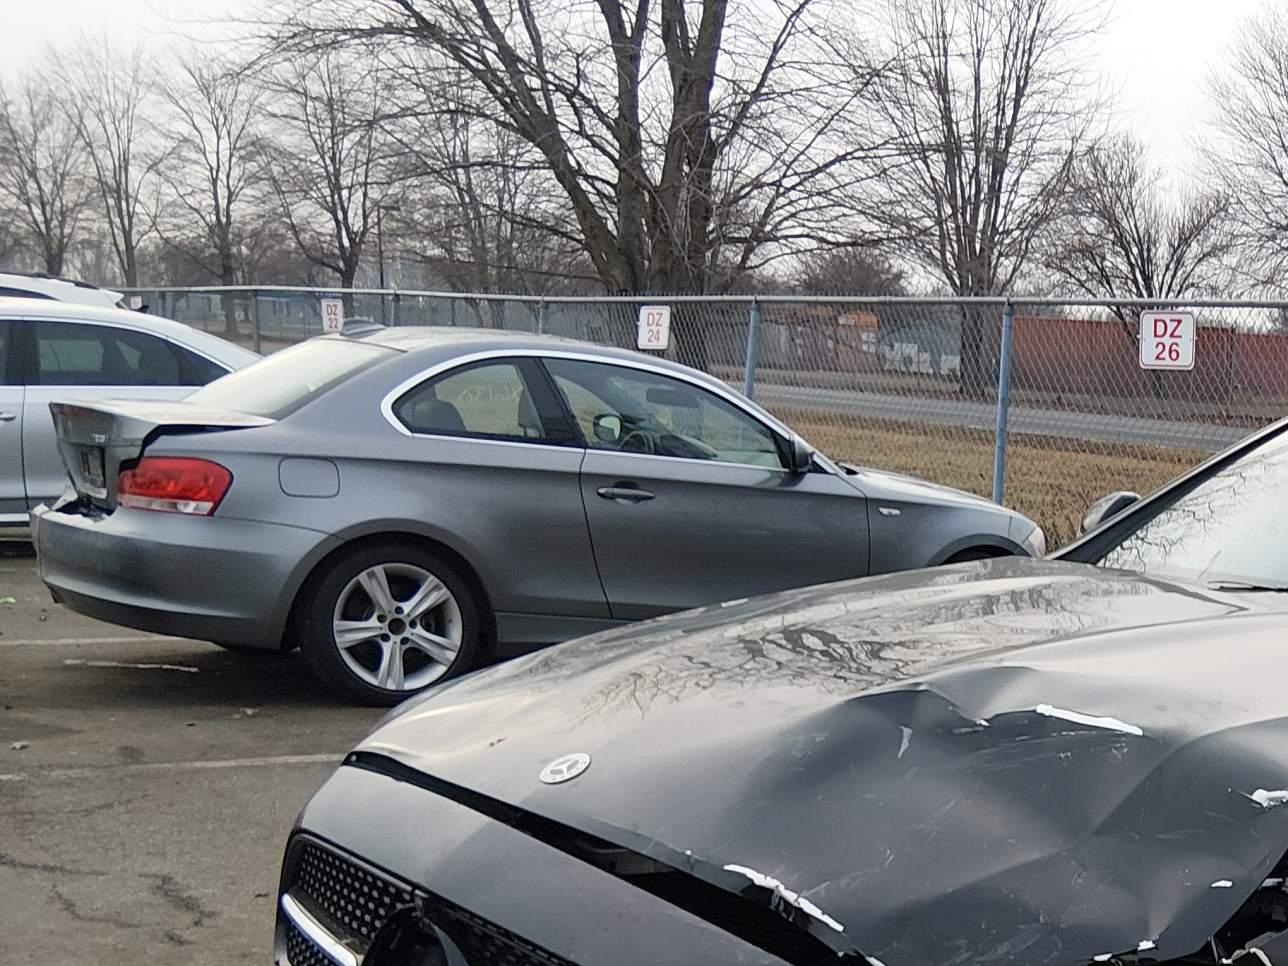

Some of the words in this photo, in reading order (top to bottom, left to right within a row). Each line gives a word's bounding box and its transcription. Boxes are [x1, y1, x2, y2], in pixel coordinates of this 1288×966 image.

[326, 303, 339, 316] DZ
[328, 317, 339, 329] 22
[646, 312, 664, 327] DZ
[647, 328, 661, 344] 24
[1153, 318, 1183, 339] DZ
[1154, 342, 1180, 361] 26
